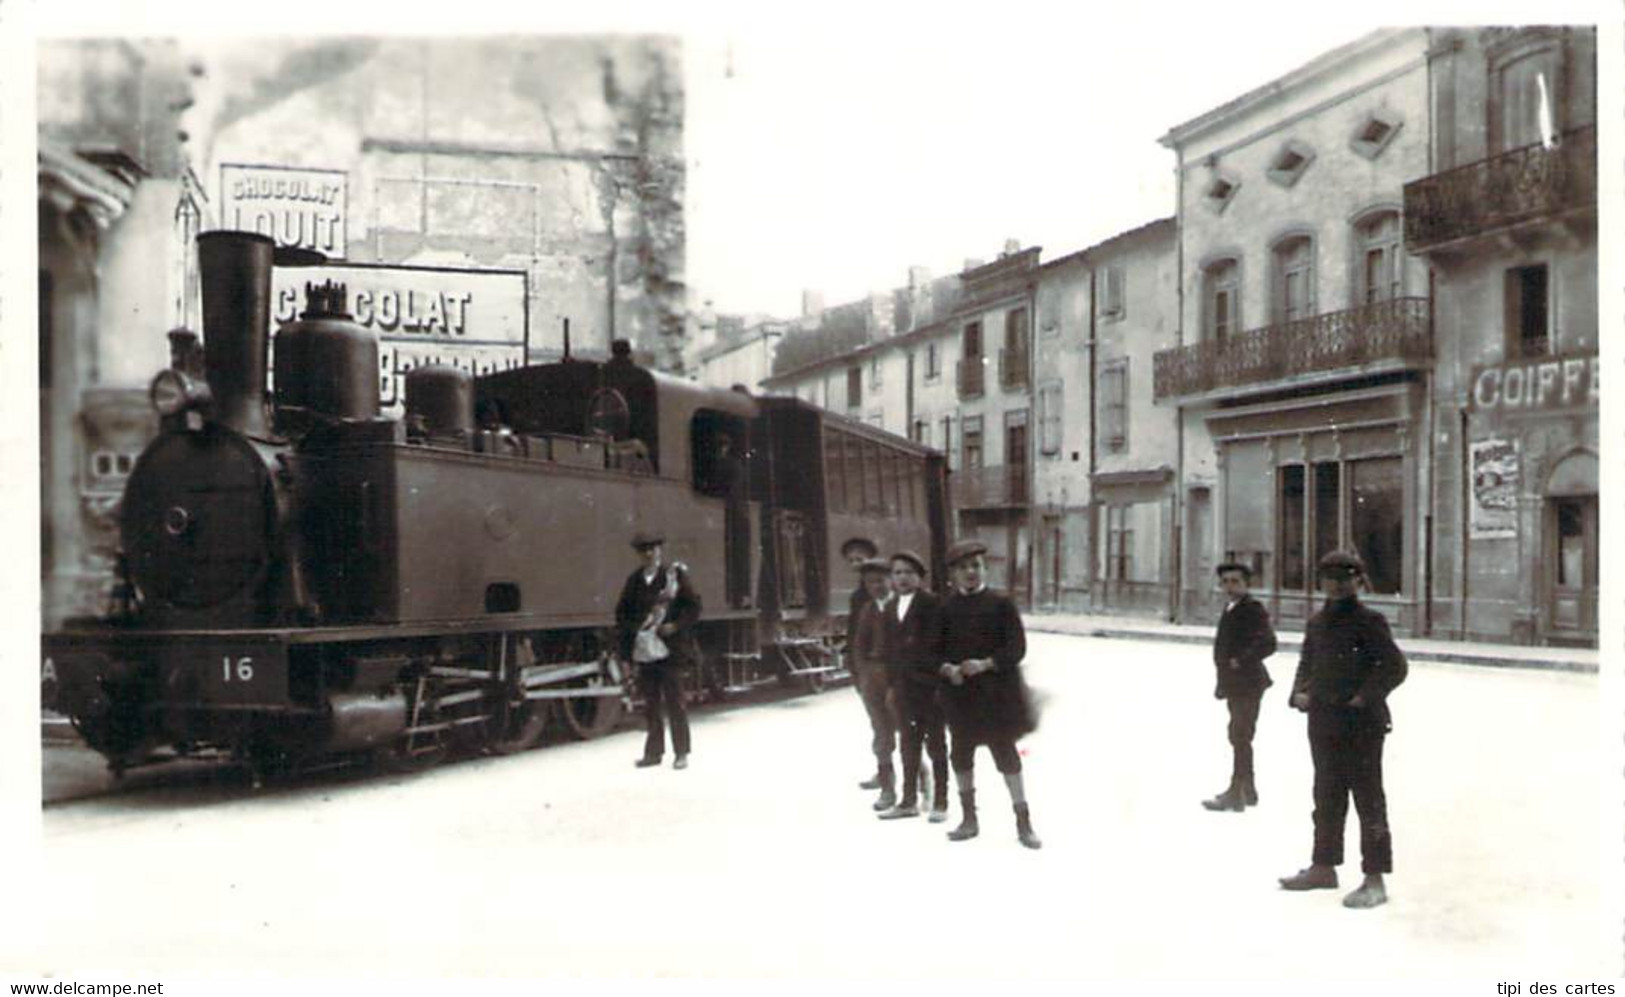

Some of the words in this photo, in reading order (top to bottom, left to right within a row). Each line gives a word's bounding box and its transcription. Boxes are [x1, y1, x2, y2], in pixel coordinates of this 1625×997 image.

[233, 178, 340, 205] CHOCOLAT
[274, 286, 472, 335] CCOLAT
[223, 656, 254, 682] 16
